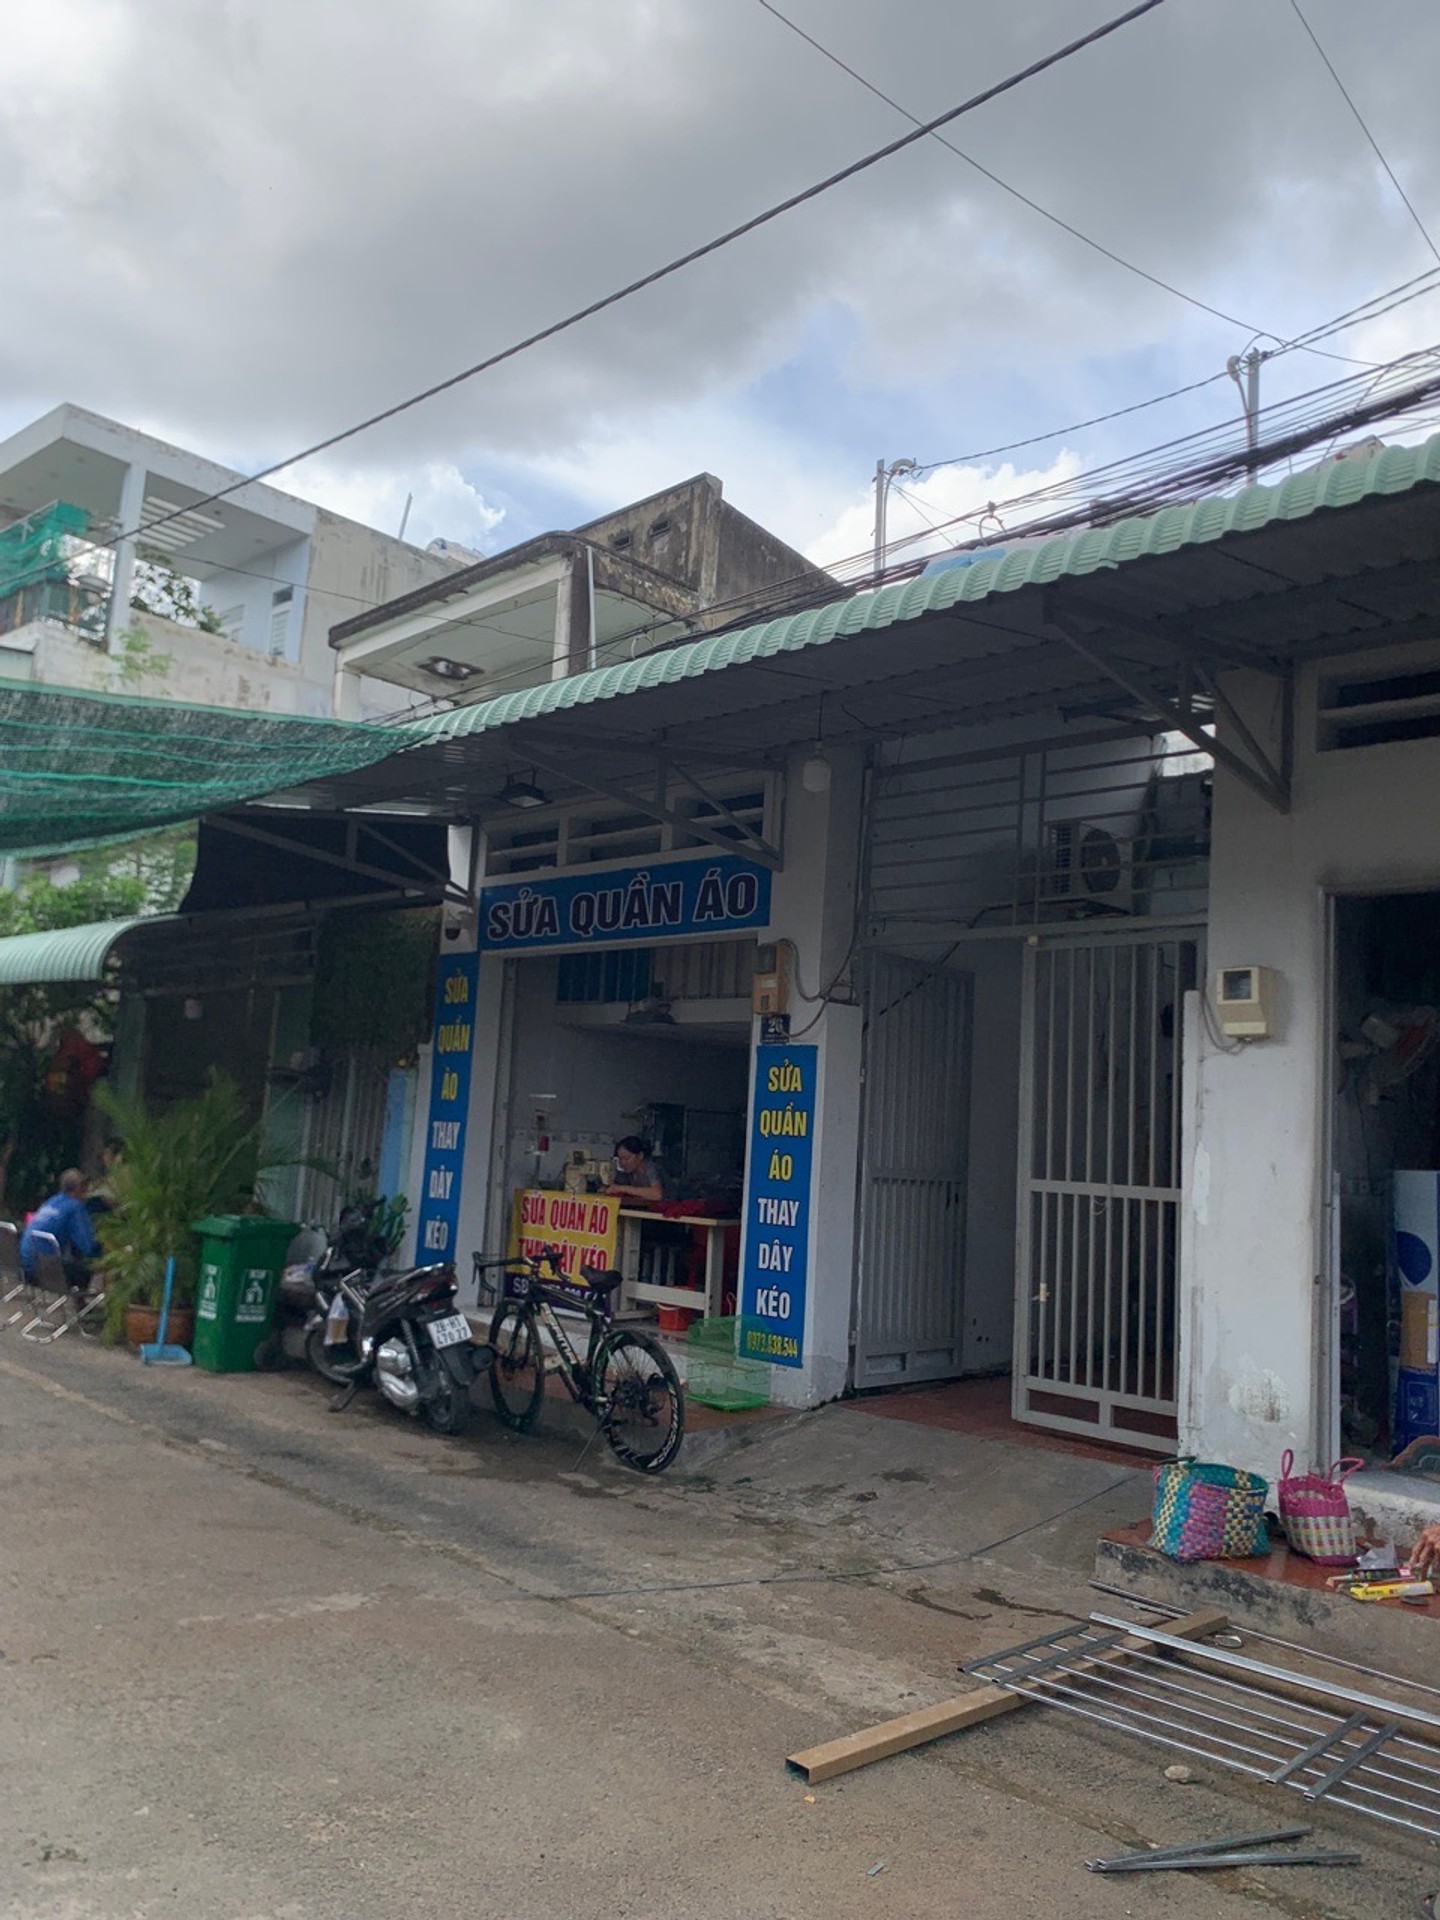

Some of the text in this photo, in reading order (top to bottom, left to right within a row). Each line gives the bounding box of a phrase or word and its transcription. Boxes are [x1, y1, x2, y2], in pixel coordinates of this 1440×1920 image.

[487, 867, 758, 942] SỬA QUẦN ÁO
[441, 1066, 459, 1100] ÁO
[768, 1058, 802, 1093] SỬA
[432, 1120, 461, 1150] THAY
[759, 1101, 807, 1138] QUẦN
[429, 1164, 454, 1200] DÂY
[768, 1149, 793, 1181] ÁO
[588, 1200, 609, 1235] ÁO
[757, 1198, 800, 1227] THAY
[424, 1215, 449, 1250] KÉO
[758, 1239, 793, 1272] DÂY
[756, 1285, 791, 1320] KÉO
